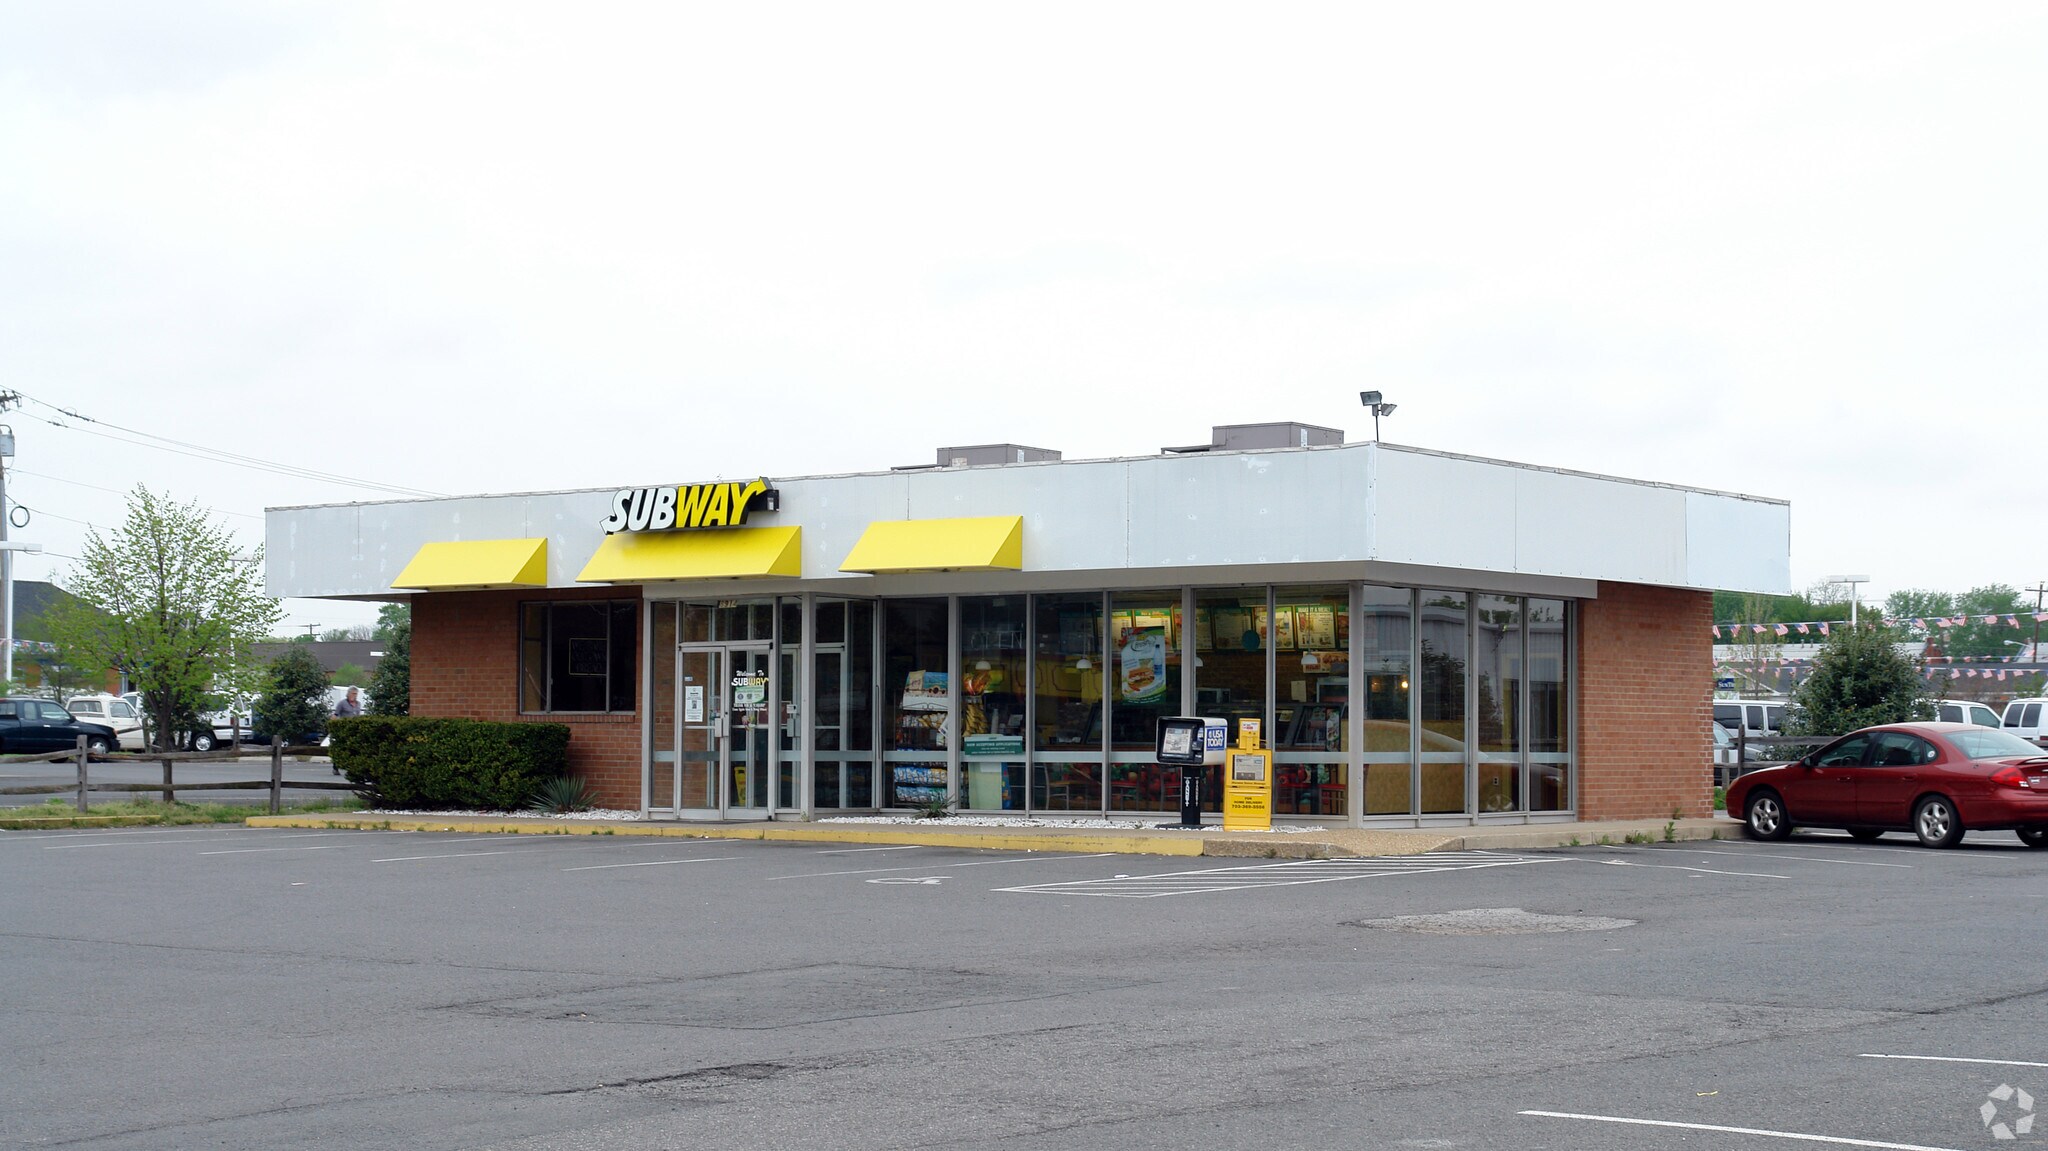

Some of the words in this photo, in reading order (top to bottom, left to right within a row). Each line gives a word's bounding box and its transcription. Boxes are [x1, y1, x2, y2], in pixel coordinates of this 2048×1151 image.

[599, 476, 766, 535] SUBWAY
[731, 677, 770, 686] SUBWAY
[1212, 730, 1223, 738] USA
[1207, 738, 1224, 747] TODAY
